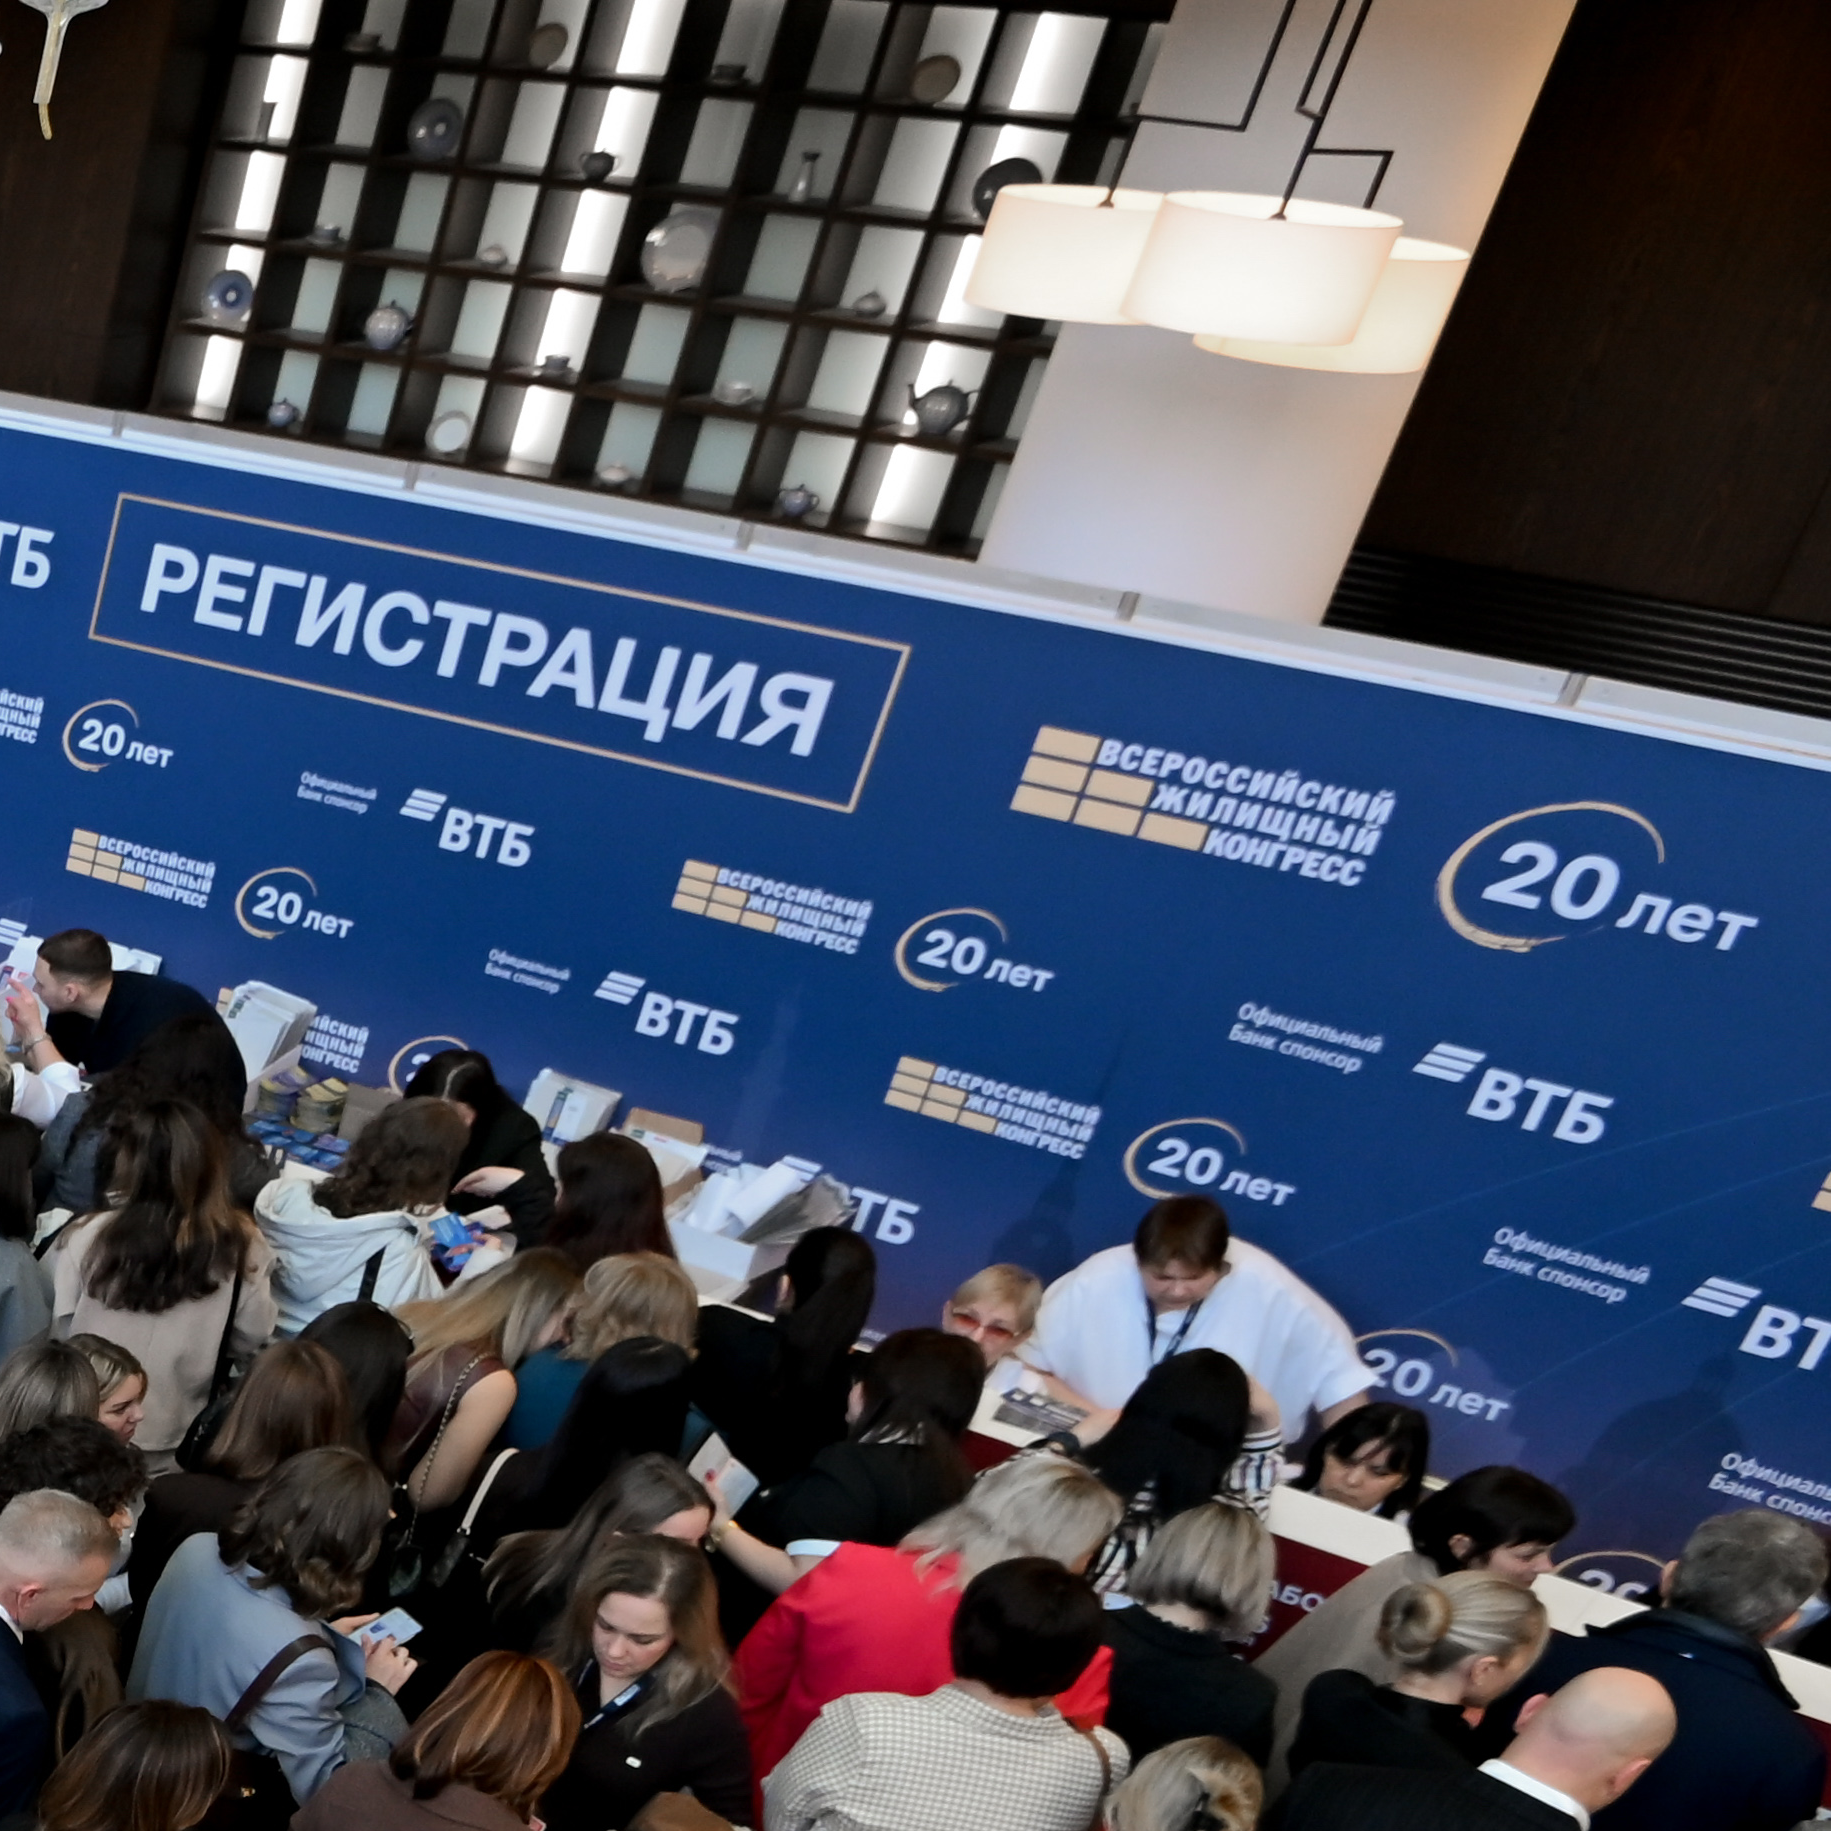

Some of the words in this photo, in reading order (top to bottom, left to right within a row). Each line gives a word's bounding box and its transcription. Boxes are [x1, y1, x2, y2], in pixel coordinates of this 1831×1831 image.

[140, 542, 834, 758] РЕГИСТРАЦИЯ
[78, 718, 126, 757] 20
[125, 740, 174, 768] лет
[1097, 737, 1397, 826] ВСЕРОССИЙСКИЙ
[438, 806, 536, 868] ВТБ
[1149, 782, 1383, 857] ЖИЛИЩНЫЙ
[98, 834, 217, 880] ВСЕРОССИЙСКИЙ
[121, 857, 213, 894] ЖИЛИЩНЫЙ
[1202, 828, 1367, 887] КОНГРЕСС
[144, 879, 209, 909] КОНГРЕСС
[252, 885, 302, 925] 20
[302, 908, 354, 939] лет
[716, 867, 874, 919] ВСЕРОССИЙСКИЙ
[745, 894, 868, 937] ЖИЛИЩНЫЙ
[1480, 840, 1622, 922] 20
[1614, 890, 1759, 953] лет
[774, 919, 860, 955] КОНГРЕСС
[916, 928, 987, 975] 20
[984, 957, 1055, 993] лет
[634, 990, 740, 1056] ВТБ
[1228, 1024, 1275, 1051] Банк
[1279, 1038, 1363, 1075] спонсор
[1238, 1001, 1384, 1054] Официальный
[301, 1045, 360, 1074] ОНГРЕСС
[933, 1065, 1103, 1127] ВСЕРОССИЙСКИЙ
[964, 1093, 1095, 1143] ЖИЛИЩНЫЙ
[1466, 1067, 1615, 1145] ВТБ
[995, 1122, 1088, 1161] КОНГРЕСС
[1147, 1136, 1224, 1186] 20
[1220, 1170, 1297, 1207] лет
[851, 1186, 921, 1245] ТБ
[1482, 1248, 1535, 1277] Банк
[1537, 1266, 1628, 1305] спонсор
[1493, 1226, 1652, 1285] Официальный
[1738, 1304, 1831, 1371] ВТ
[1364, 1348, 1432, 1399] 20
[1432, 1383, 1510, 1421] лет
[1708, 1471, 1764, 1504] Банк
[1766, 1494, 1831, 1526] спонс
